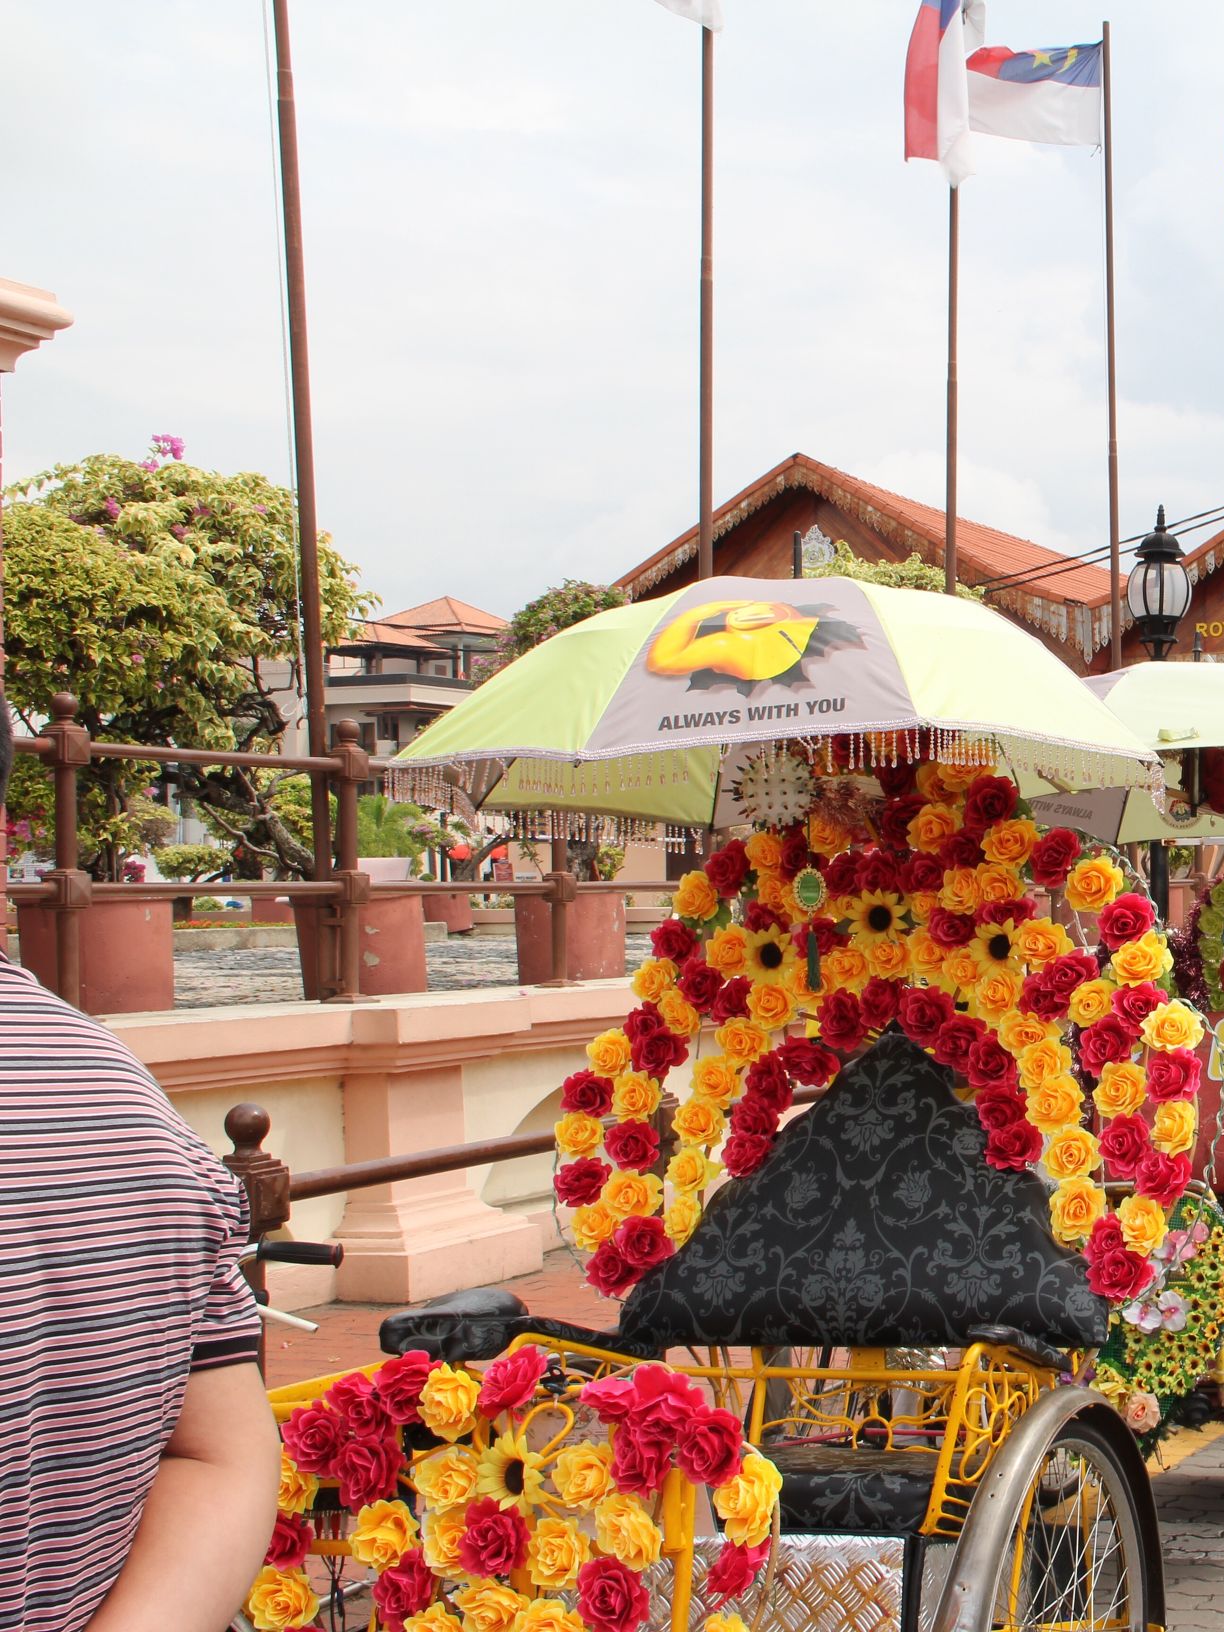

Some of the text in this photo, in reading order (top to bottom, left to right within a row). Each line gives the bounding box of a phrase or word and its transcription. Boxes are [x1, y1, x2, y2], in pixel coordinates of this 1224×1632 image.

[658, 698, 845, 731] ALWAYS WITH YOU
